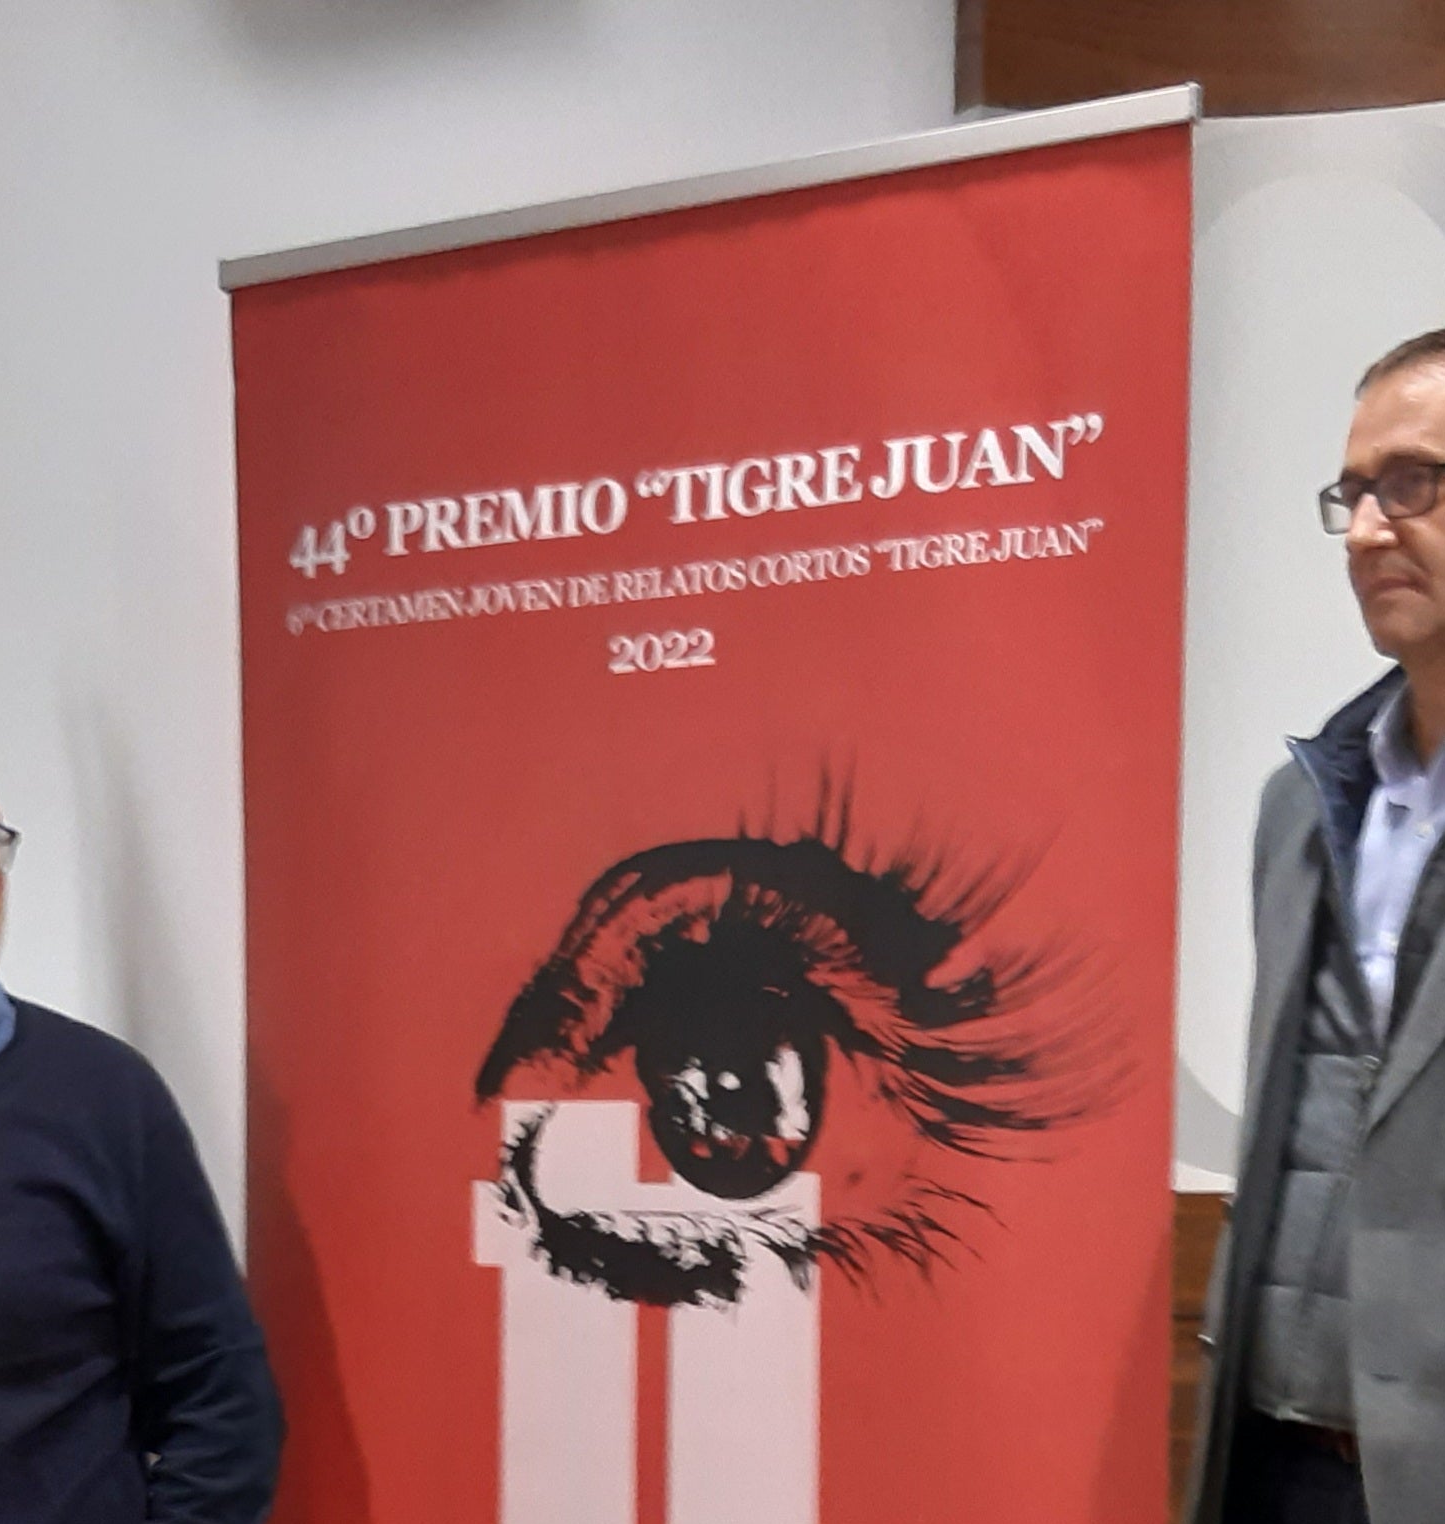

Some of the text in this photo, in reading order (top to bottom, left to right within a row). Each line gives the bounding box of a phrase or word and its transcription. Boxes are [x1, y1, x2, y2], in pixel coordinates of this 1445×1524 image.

[384, 477, 629, 556] PREMIO
[316, 590, 464, 632] CERTAMEN
[465, 578, 562, 616] JOVEN
[566, 574, 609, 608] DE
[612, 557, 748, 603] RELATOS
[750, 544, 871, 588] CORTOS
[608, 627, 716, 674] 2022
